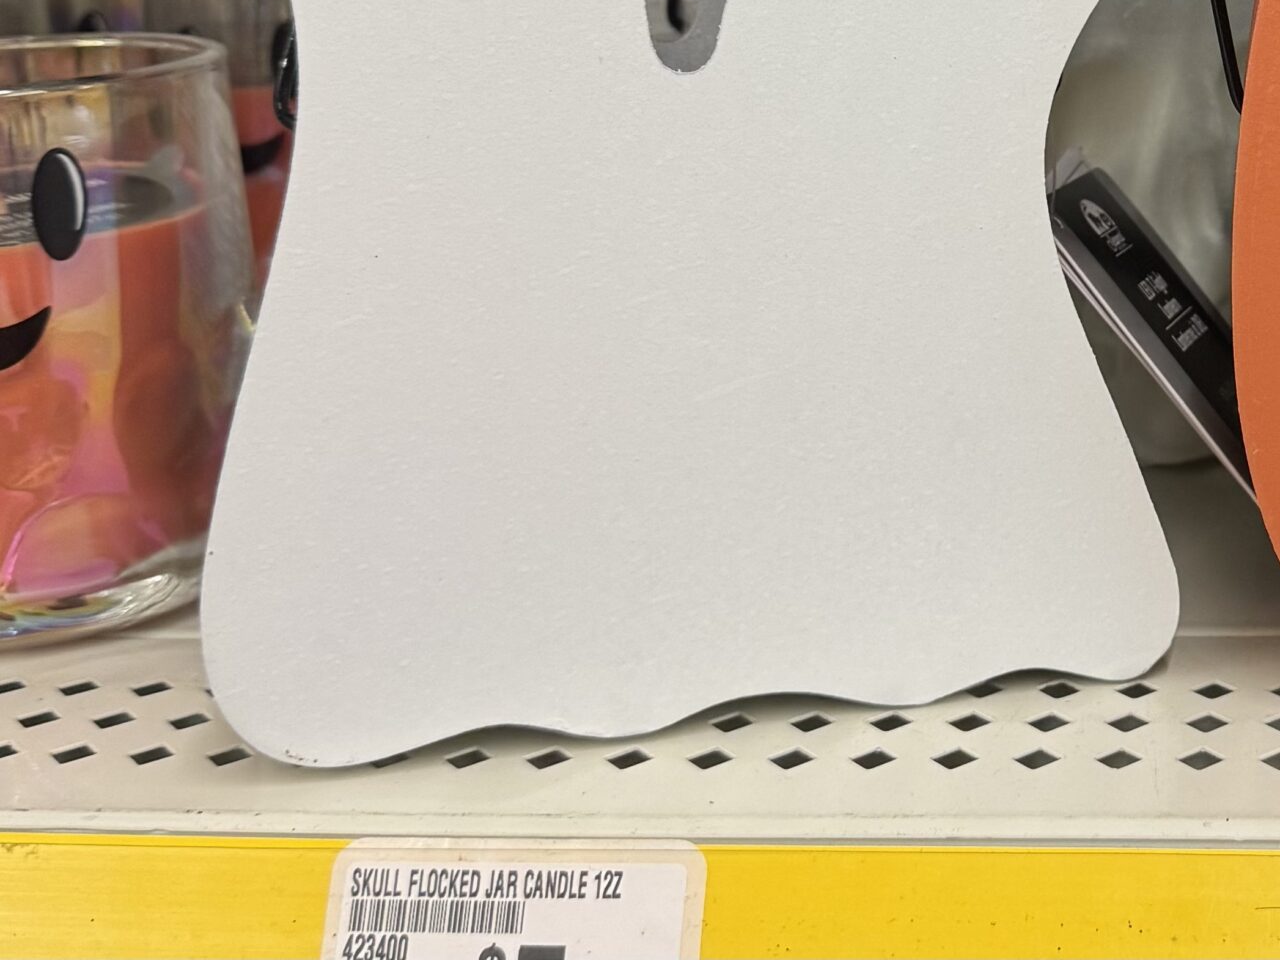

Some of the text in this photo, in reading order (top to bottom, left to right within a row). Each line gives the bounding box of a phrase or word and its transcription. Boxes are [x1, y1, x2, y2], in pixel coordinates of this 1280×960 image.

[351, 867, 624, 900] SKULL FLOCKED JAR CANDLE 12Z
[342, 933, 410, 960] 423400
